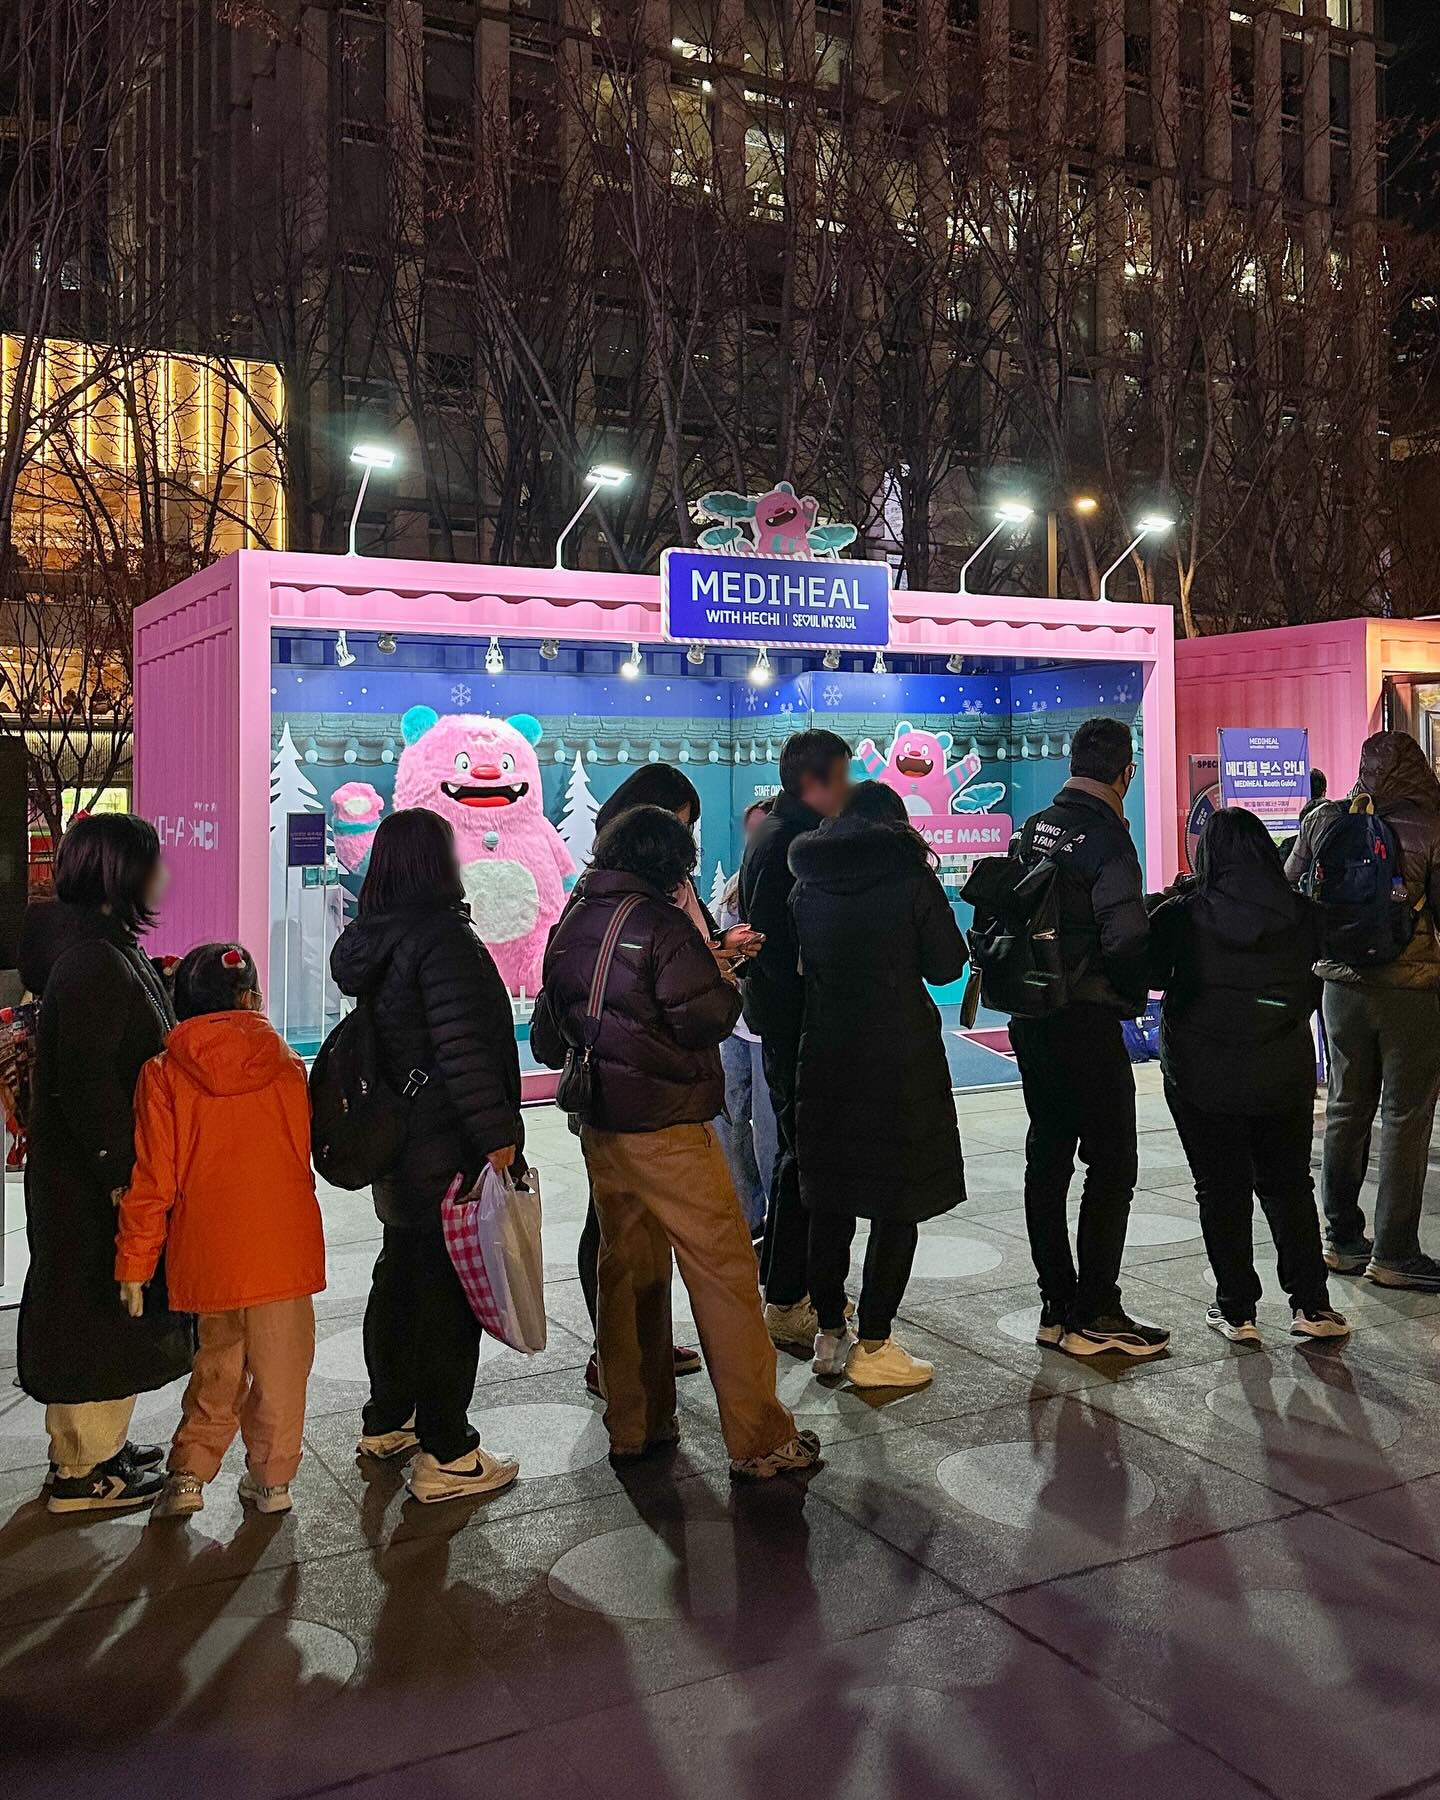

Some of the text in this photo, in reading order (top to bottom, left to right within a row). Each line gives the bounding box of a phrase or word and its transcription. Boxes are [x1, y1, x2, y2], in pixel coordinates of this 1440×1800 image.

[691, 569, 870, 610] MEDIHEAL
[706, 609, 741, 625] WITH
[743, 611, 780, 626] HECHI
[1249, 737, 1280, 745] MEDIHEAL
[1225, 760, 1306, 777] 메디힐 부스 안내
[754, 784, 771, 797] STAFF
[1234, 779, 1297, 788] MEDIHEAL Booth Guide
[922, 829, 954, 844] ACE
[957, 828, 1001, 843] MASK
